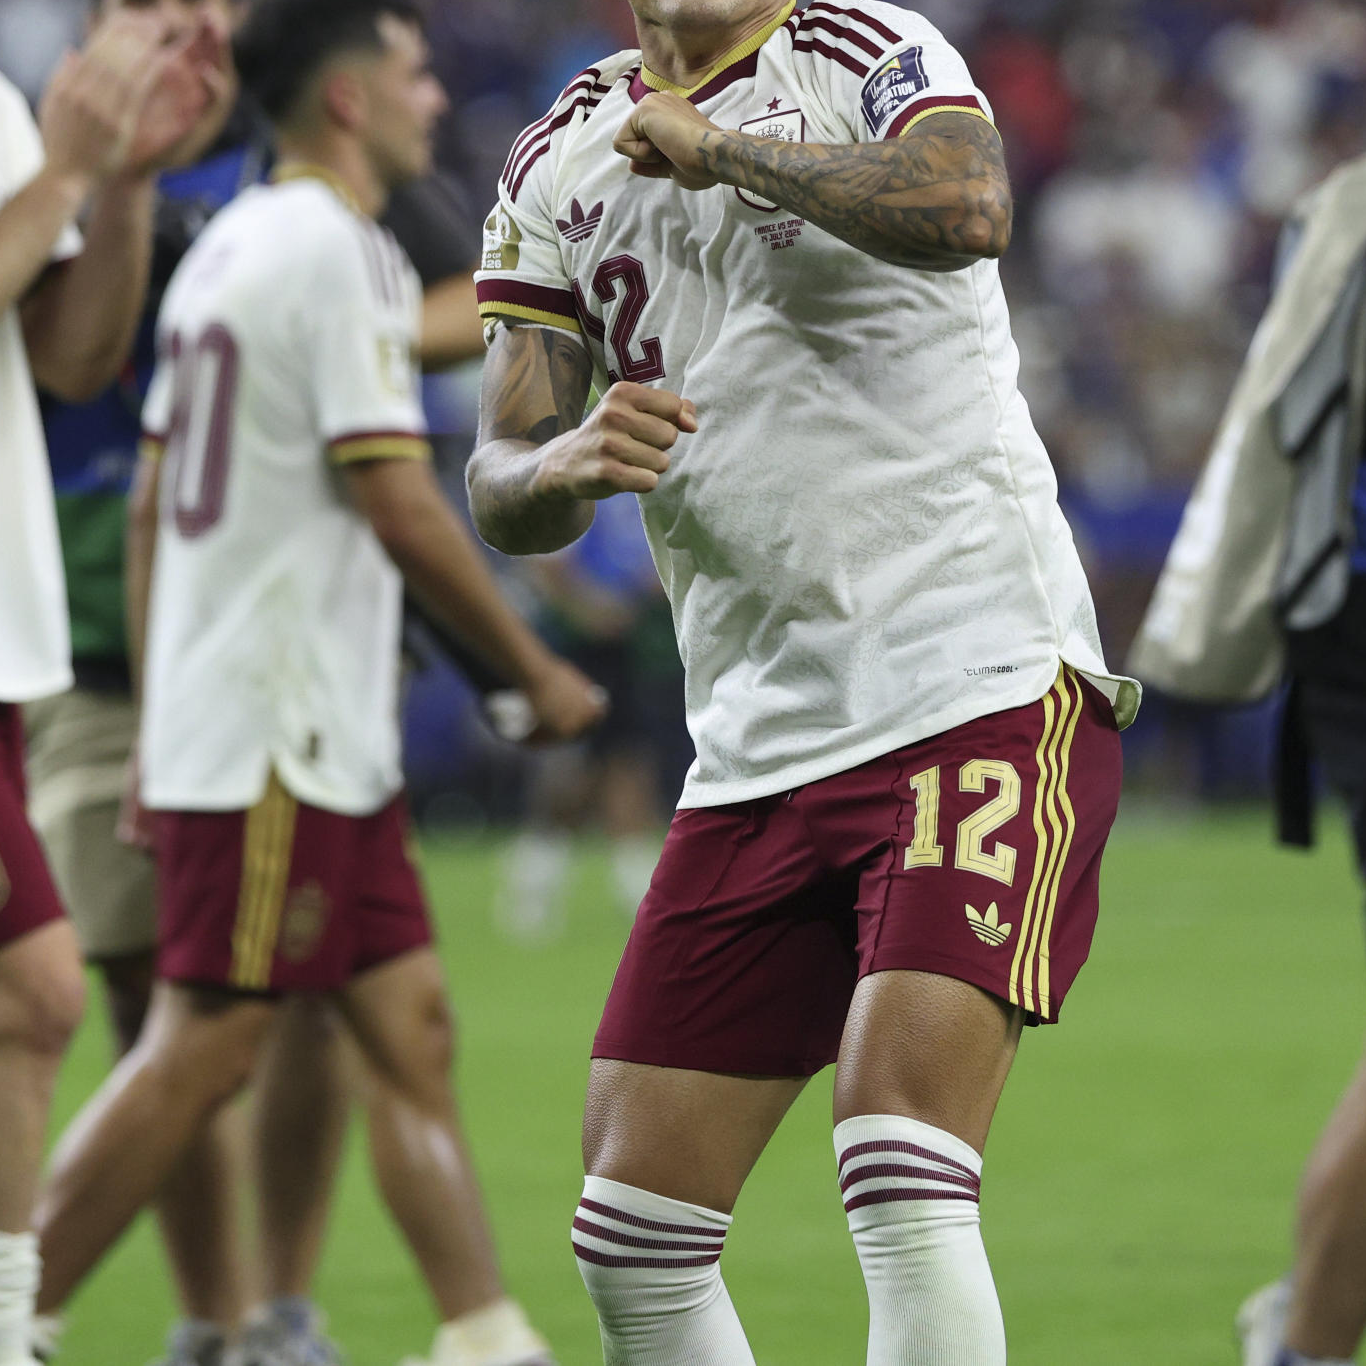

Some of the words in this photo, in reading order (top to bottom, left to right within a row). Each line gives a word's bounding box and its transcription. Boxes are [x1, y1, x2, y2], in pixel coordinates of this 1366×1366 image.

[872, 81, 916, 117] EDUCATION
[769, 232, 783, 243] JULY
[784, 228, 802, 238] 2026
[771, 238, 794, 250] DALLAS
[903, 758, 1022, 888] 12
